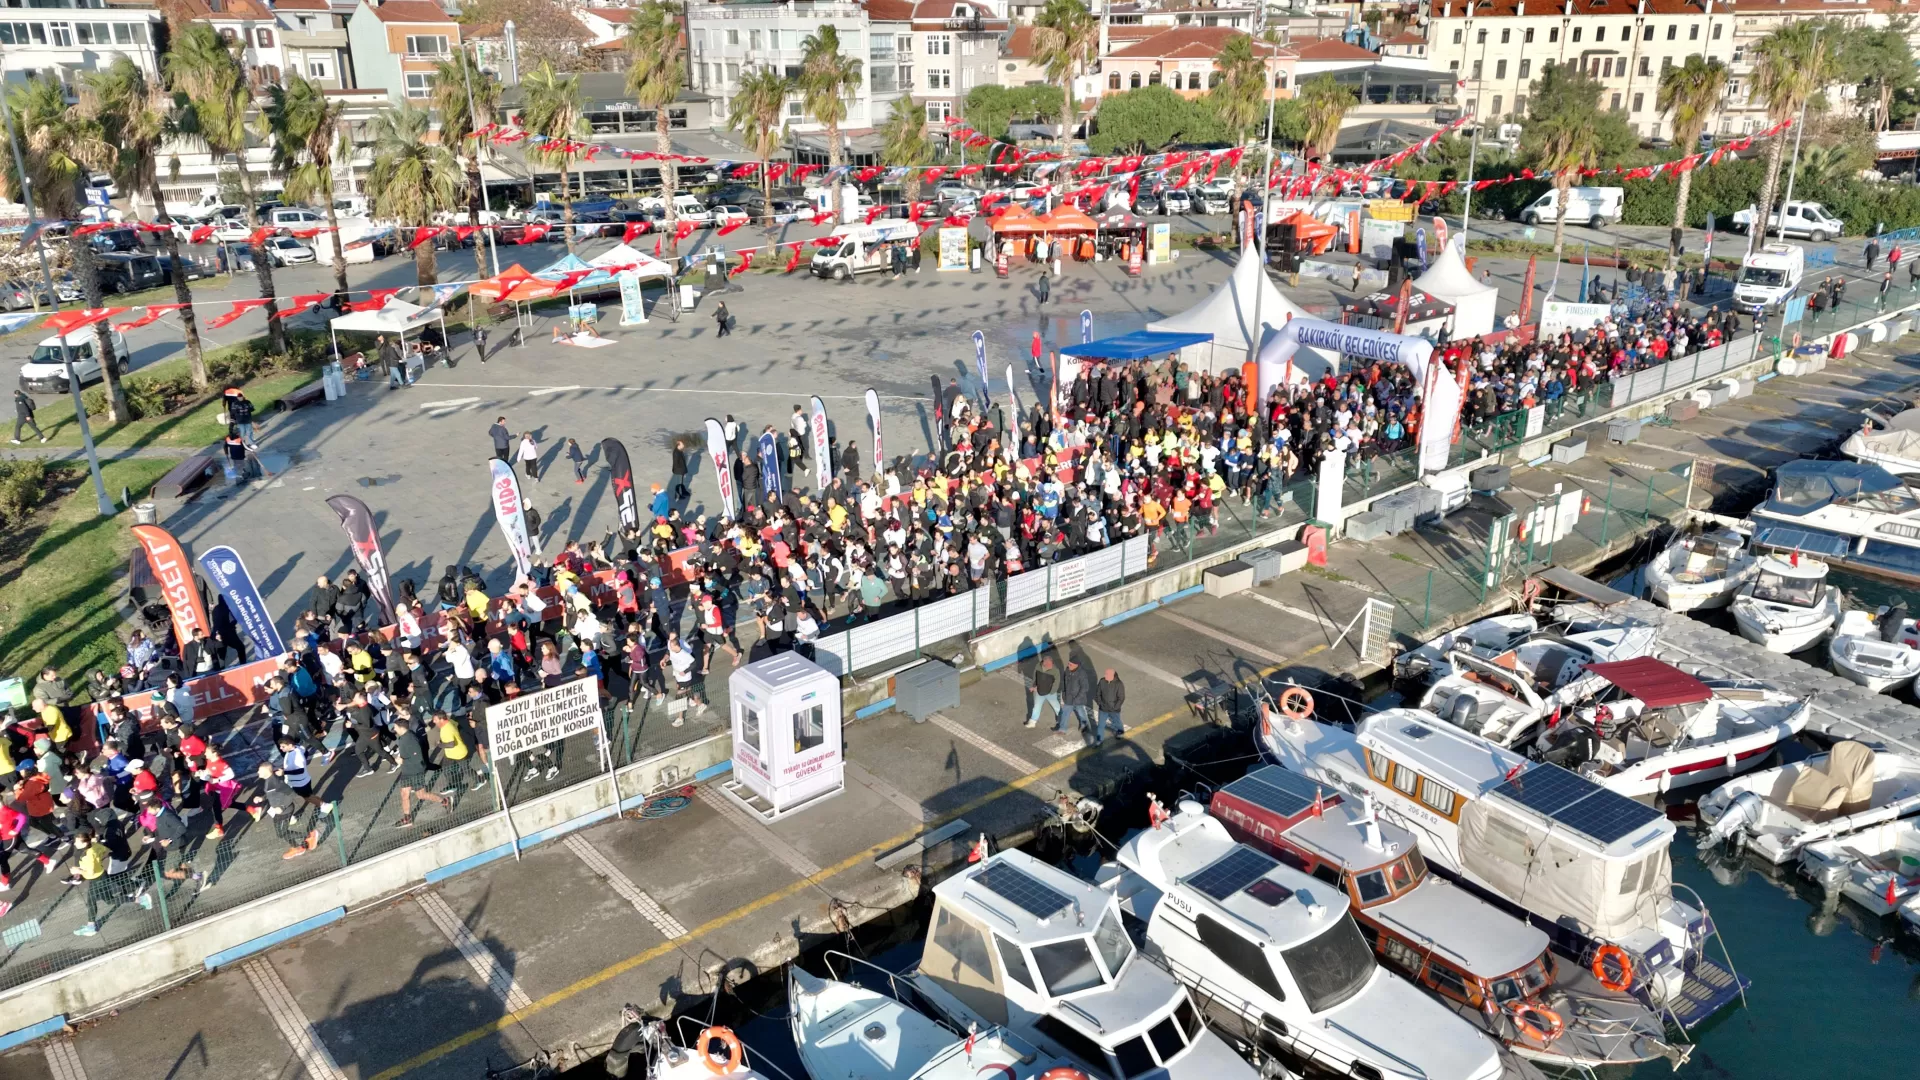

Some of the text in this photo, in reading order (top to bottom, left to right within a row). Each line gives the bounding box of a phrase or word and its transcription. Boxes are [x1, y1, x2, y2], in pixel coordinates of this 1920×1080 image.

[1566, 305, 1599, 315] FINISHER
[1298, 326, 1403, 362] BAKIRKÖY BELEDİYESİ
[497, 694, 588, 731] HAYATI TÜKETMEKTİR
[505, 683, 584, 716] SUYU KİRLETMEK
[495, 730, 511, 745] BİZ
[549, 702, 599, 724] KORURSAK
[526, 734, 539, 748] DA
[564, 715, 595, 735] KORUR
[795, 762, 823, 779] GÜVENLİK
[1430, 816, 1438, 825] 42
[1167, 892, 1192, 913] PUSU
